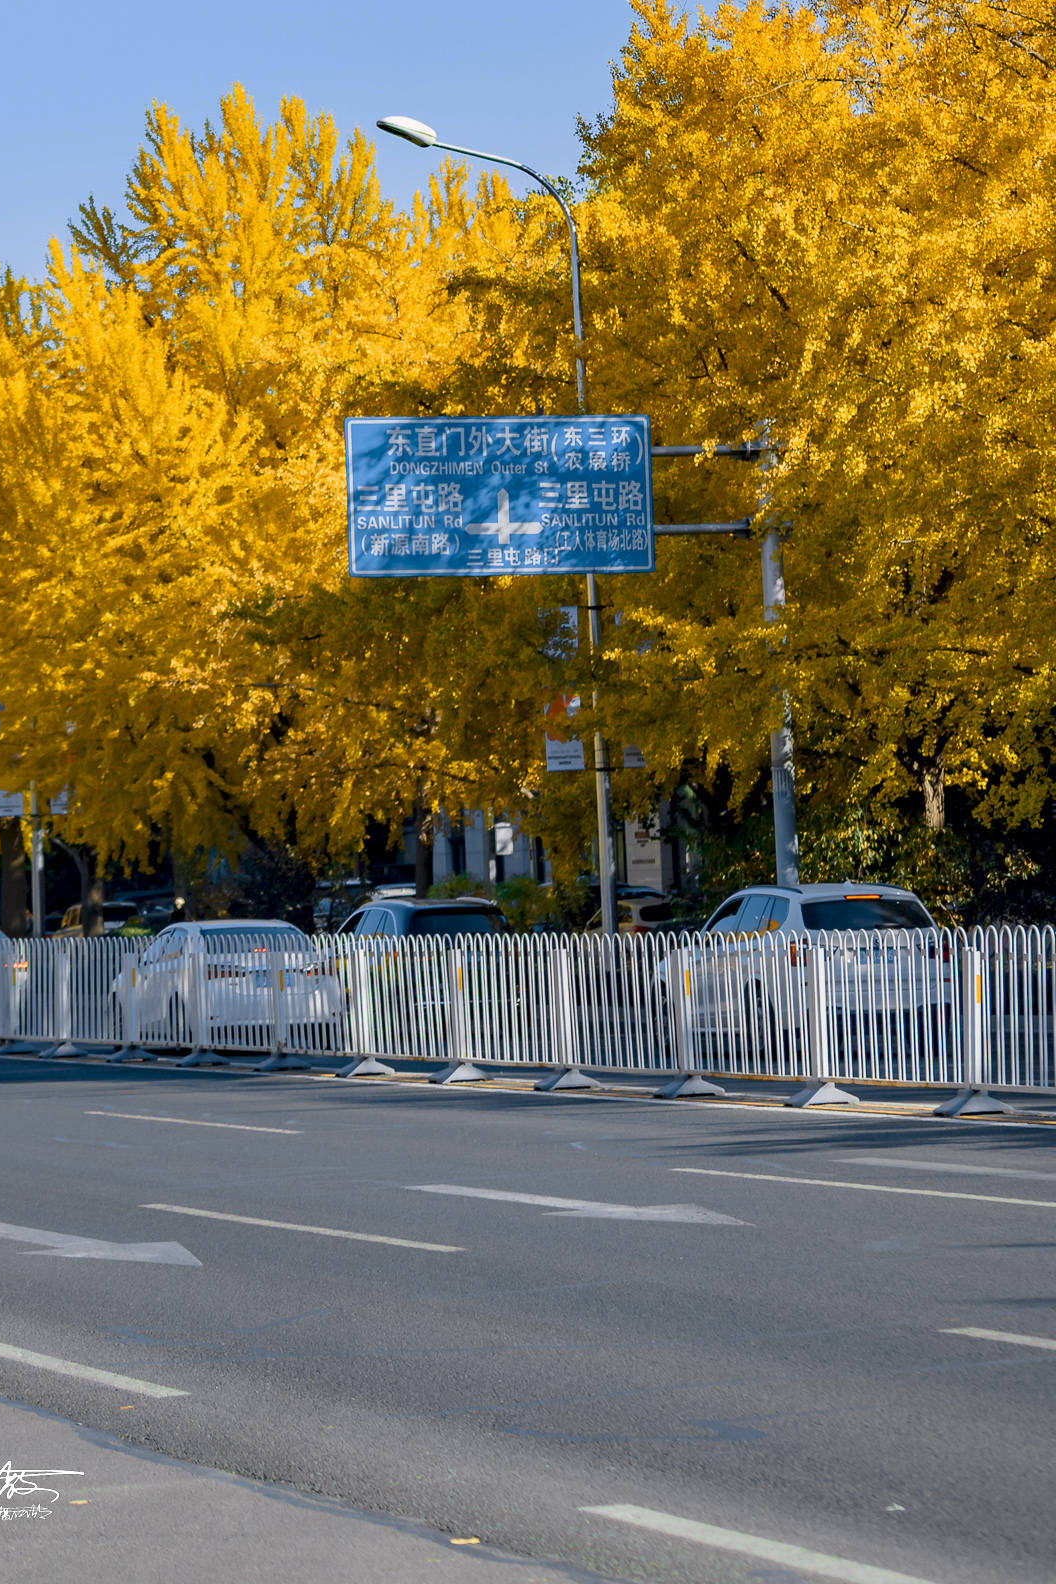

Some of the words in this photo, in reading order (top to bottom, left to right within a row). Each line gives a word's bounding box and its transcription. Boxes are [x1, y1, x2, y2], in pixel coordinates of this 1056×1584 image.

[386, 425, 549, 457] 东直门外大街
[390, 461, 484, 475] DONGZHIMEN
[491, 461, 527, 474] Outer
[534, 460, 549, 474] St
[357, 482, 464, 513] 三里屯路
[539, 480, 644, 511] 三里屯路
[357, 515, 435, 530] SANLITUN
[443, 514, 463, 529] Rd
[541, 513, 619, 527] SANLITUN
[626, 512, 646, 526] Rd
[467, 547, 559, 567] 三里屯路口
